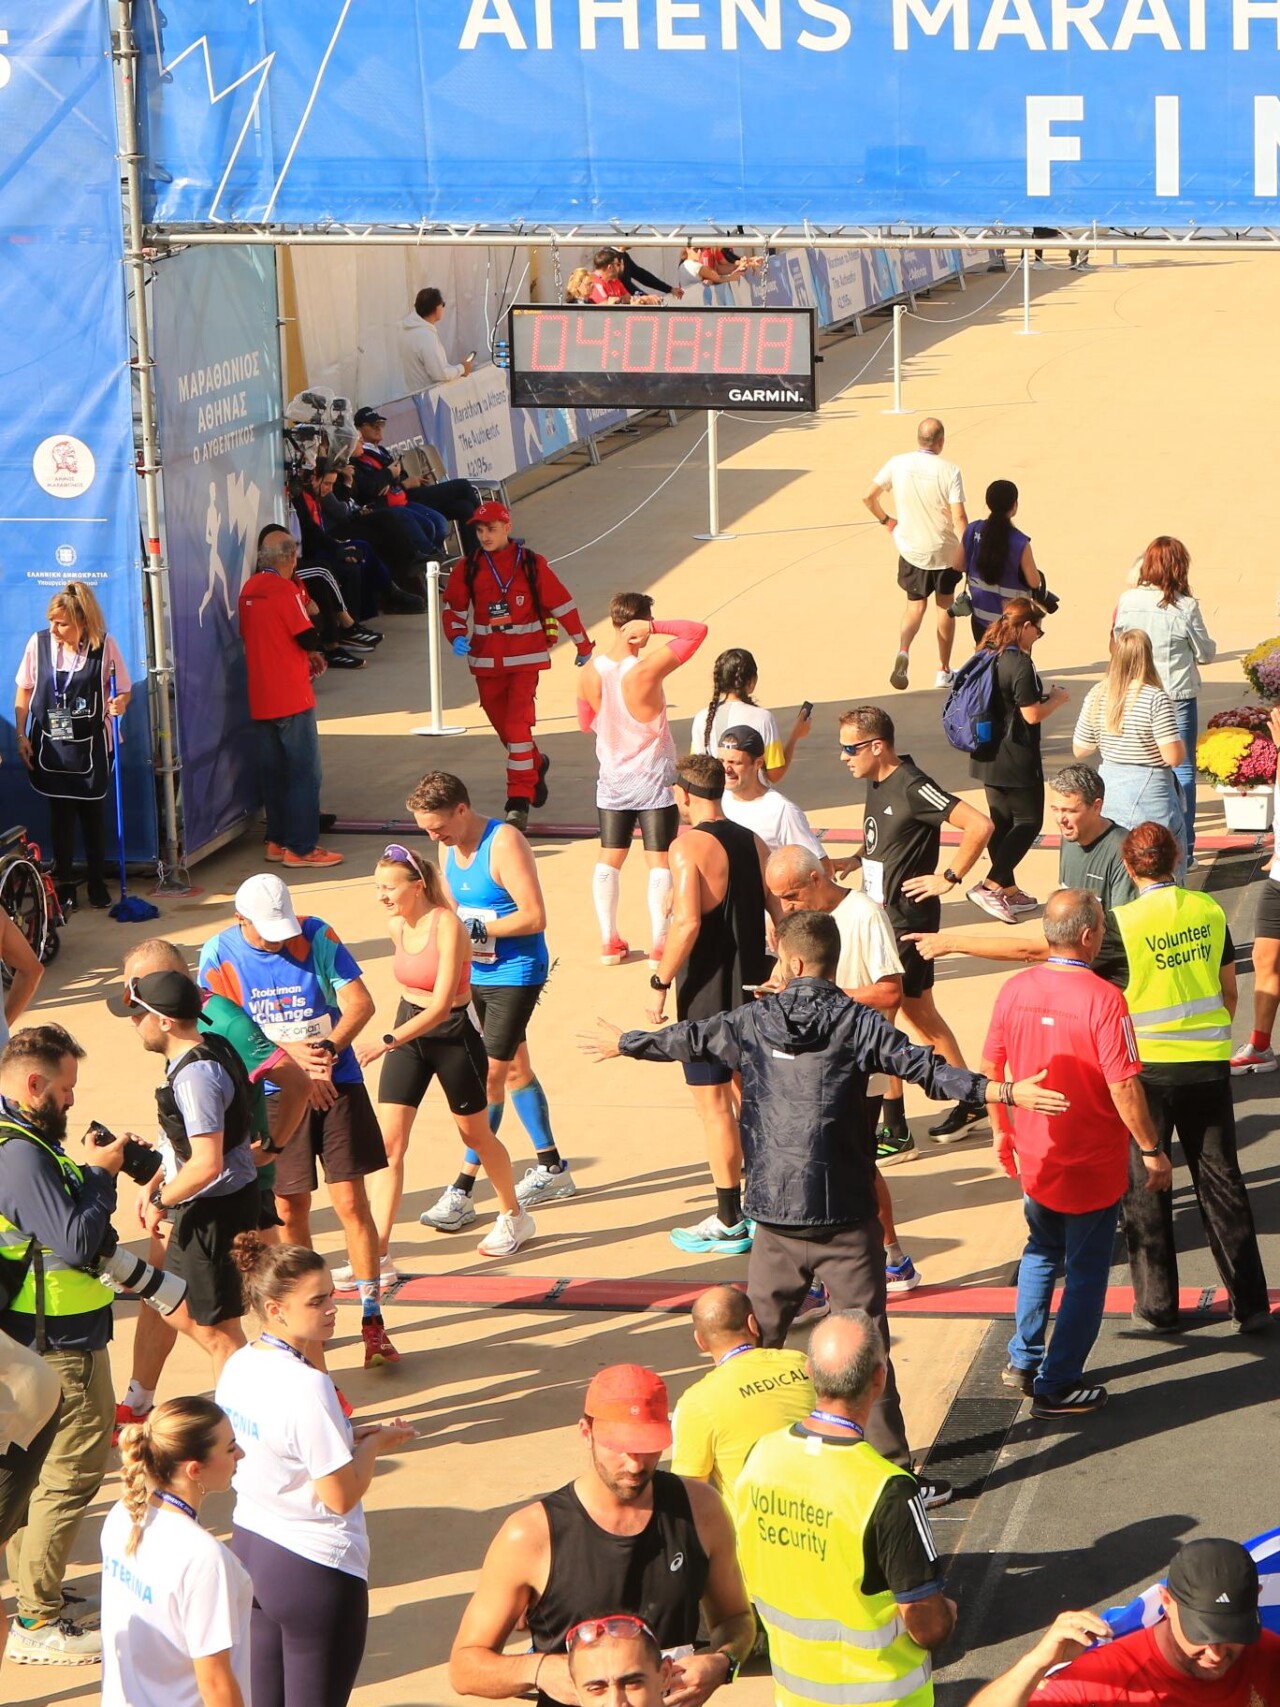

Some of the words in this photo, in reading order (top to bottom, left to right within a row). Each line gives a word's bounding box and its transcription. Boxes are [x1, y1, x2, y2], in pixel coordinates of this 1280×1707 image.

[457, 0, 852, 52] ATHENS
[531, 313, 794, 374] 04:08:08
[178, 350, 260, 403] ΜΑΡΑΘΩΝΙΟΣ
[198, 391, 248, 433] ΑΘΗΝΑΣ
[1145, 923, 1211, 952] Volunteer
[1155, 943, 1211, 970] Security
[250, 985, 302, 999] Stoiximan
[738, 1368, 809, 1398] MEDICAL
[750, 1485, 833, 1529] Volunteer
[757, 1516, 827, 1561] Security
